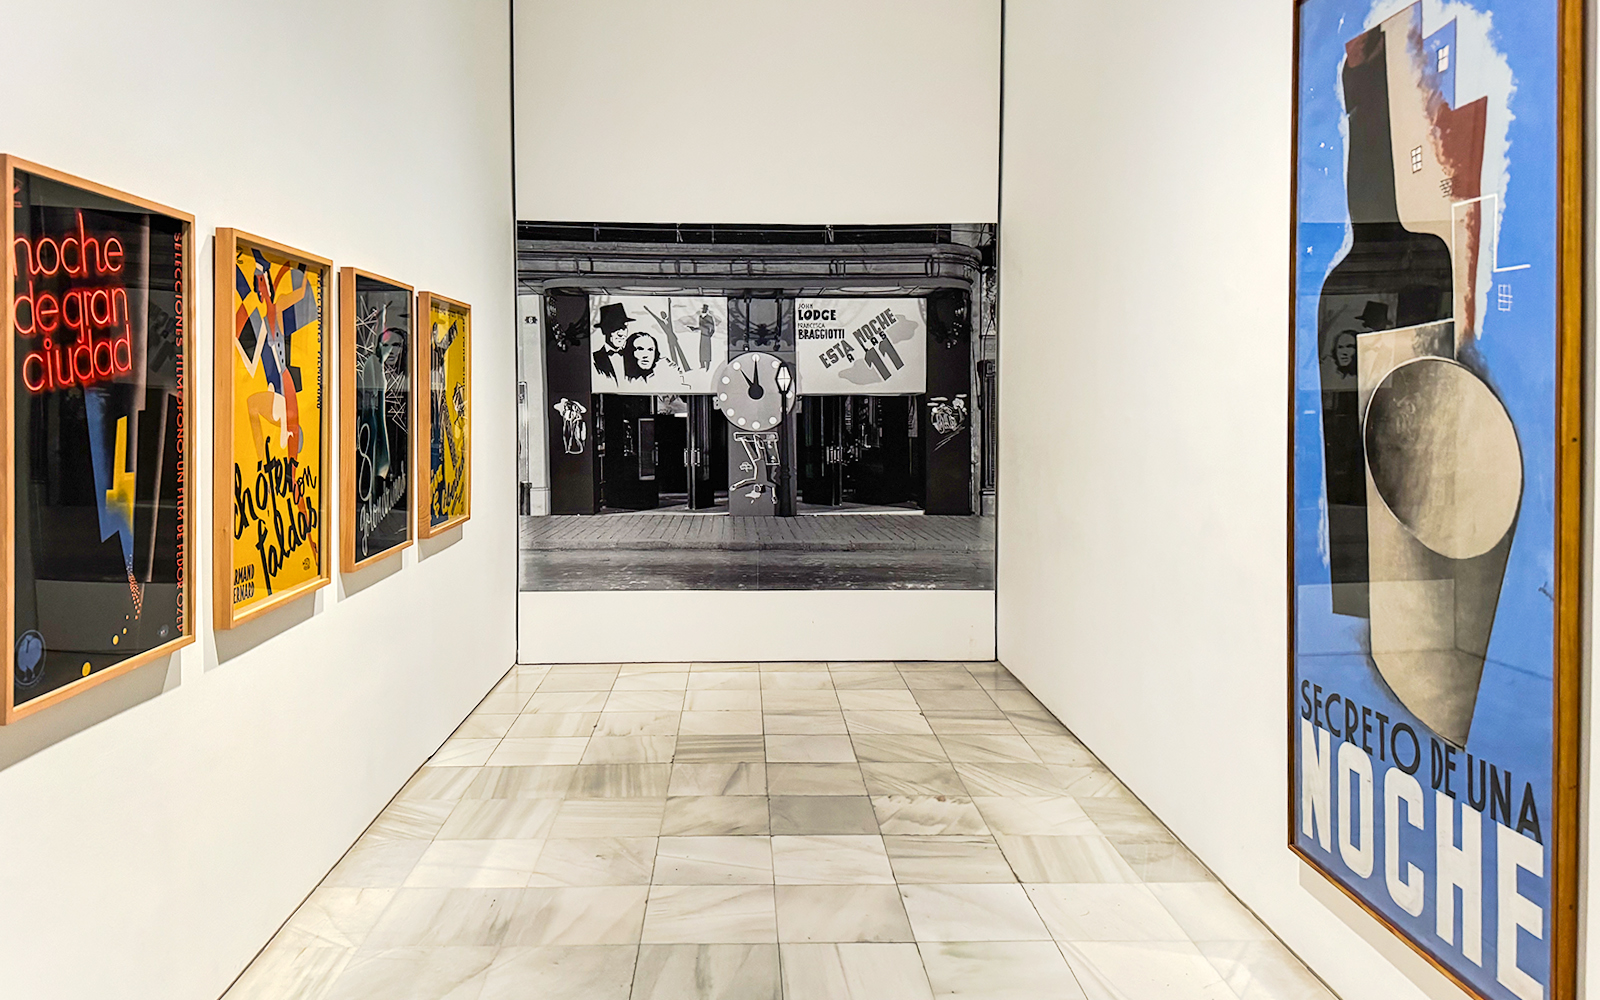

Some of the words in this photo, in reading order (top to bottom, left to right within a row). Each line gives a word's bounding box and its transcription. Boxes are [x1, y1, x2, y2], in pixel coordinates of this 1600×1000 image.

[13, 208, 123, 277] noche
[14, 281, 59, 334] de
[63, 287, 129, 343] gran
[174, 232, 184, 347] SELECCIONES
[798, 309, 837, 321] LODGE
[23, 324, 133, 391] ciudad
[798, 328, 845, 340] BRAGGIOTTI
[818, 339, 855, 369] ESTA
[852, 308, 897, 346] NOCHE
[864, 337, 905, 381] 11
[176, 461, 184, 483] UN
[176, 487, 184, 520] FILM
[176, 524, 184, 540] DE
[255, 496, 318, 595] faldas
[234, 563, 255, 585] RMAND
[234, 581, 255, 604] ERNARD
[1300, 679, 1421, 776] SECRETO
[1430, 736, 1456, 800] DE
[1467, 753, 1543, 845] UNA
[1301, 717, 1544, 1000] NOCHE
